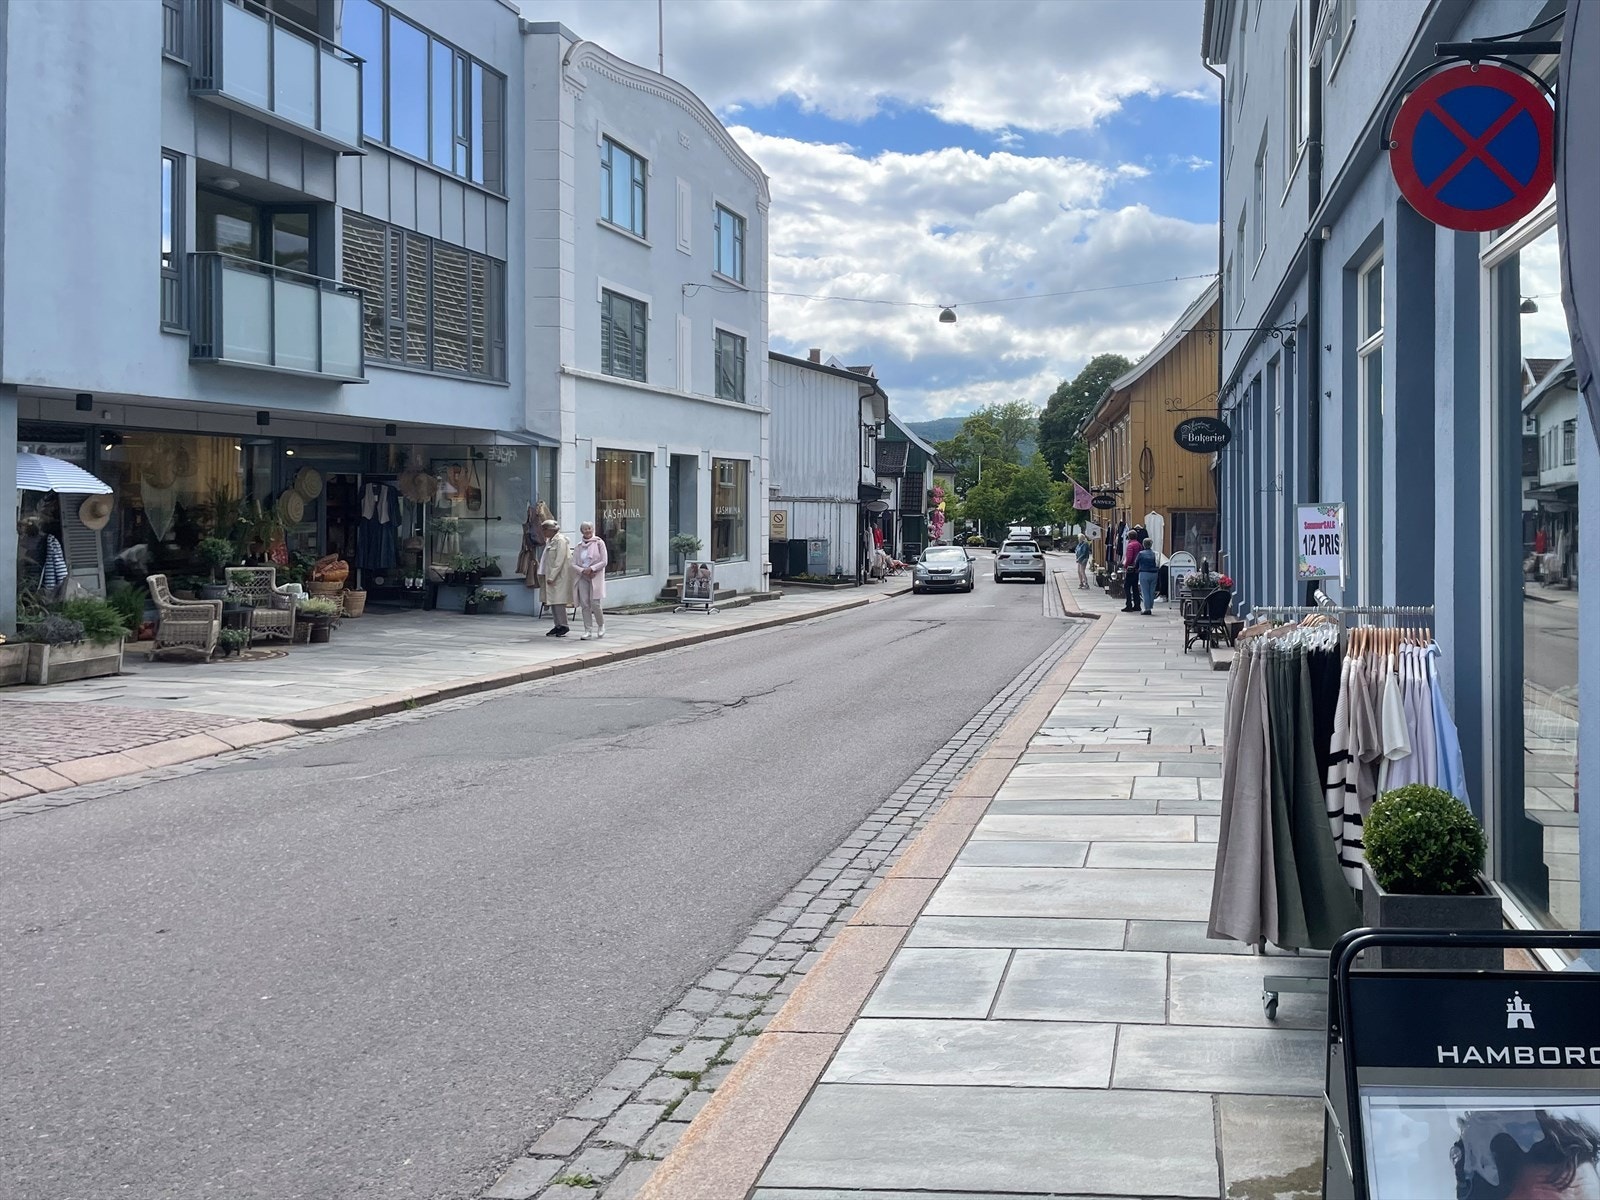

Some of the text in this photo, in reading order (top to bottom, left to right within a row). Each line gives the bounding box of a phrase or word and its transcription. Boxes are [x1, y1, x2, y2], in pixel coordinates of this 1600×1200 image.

[1188, 432, 1225, 444] Bakeriet
[603, 508, 641, 520] KASHMINA
[715, 505, 741, 515] KASHMINA
[1303, 533, 1340, 556] 1/2 PRIS
